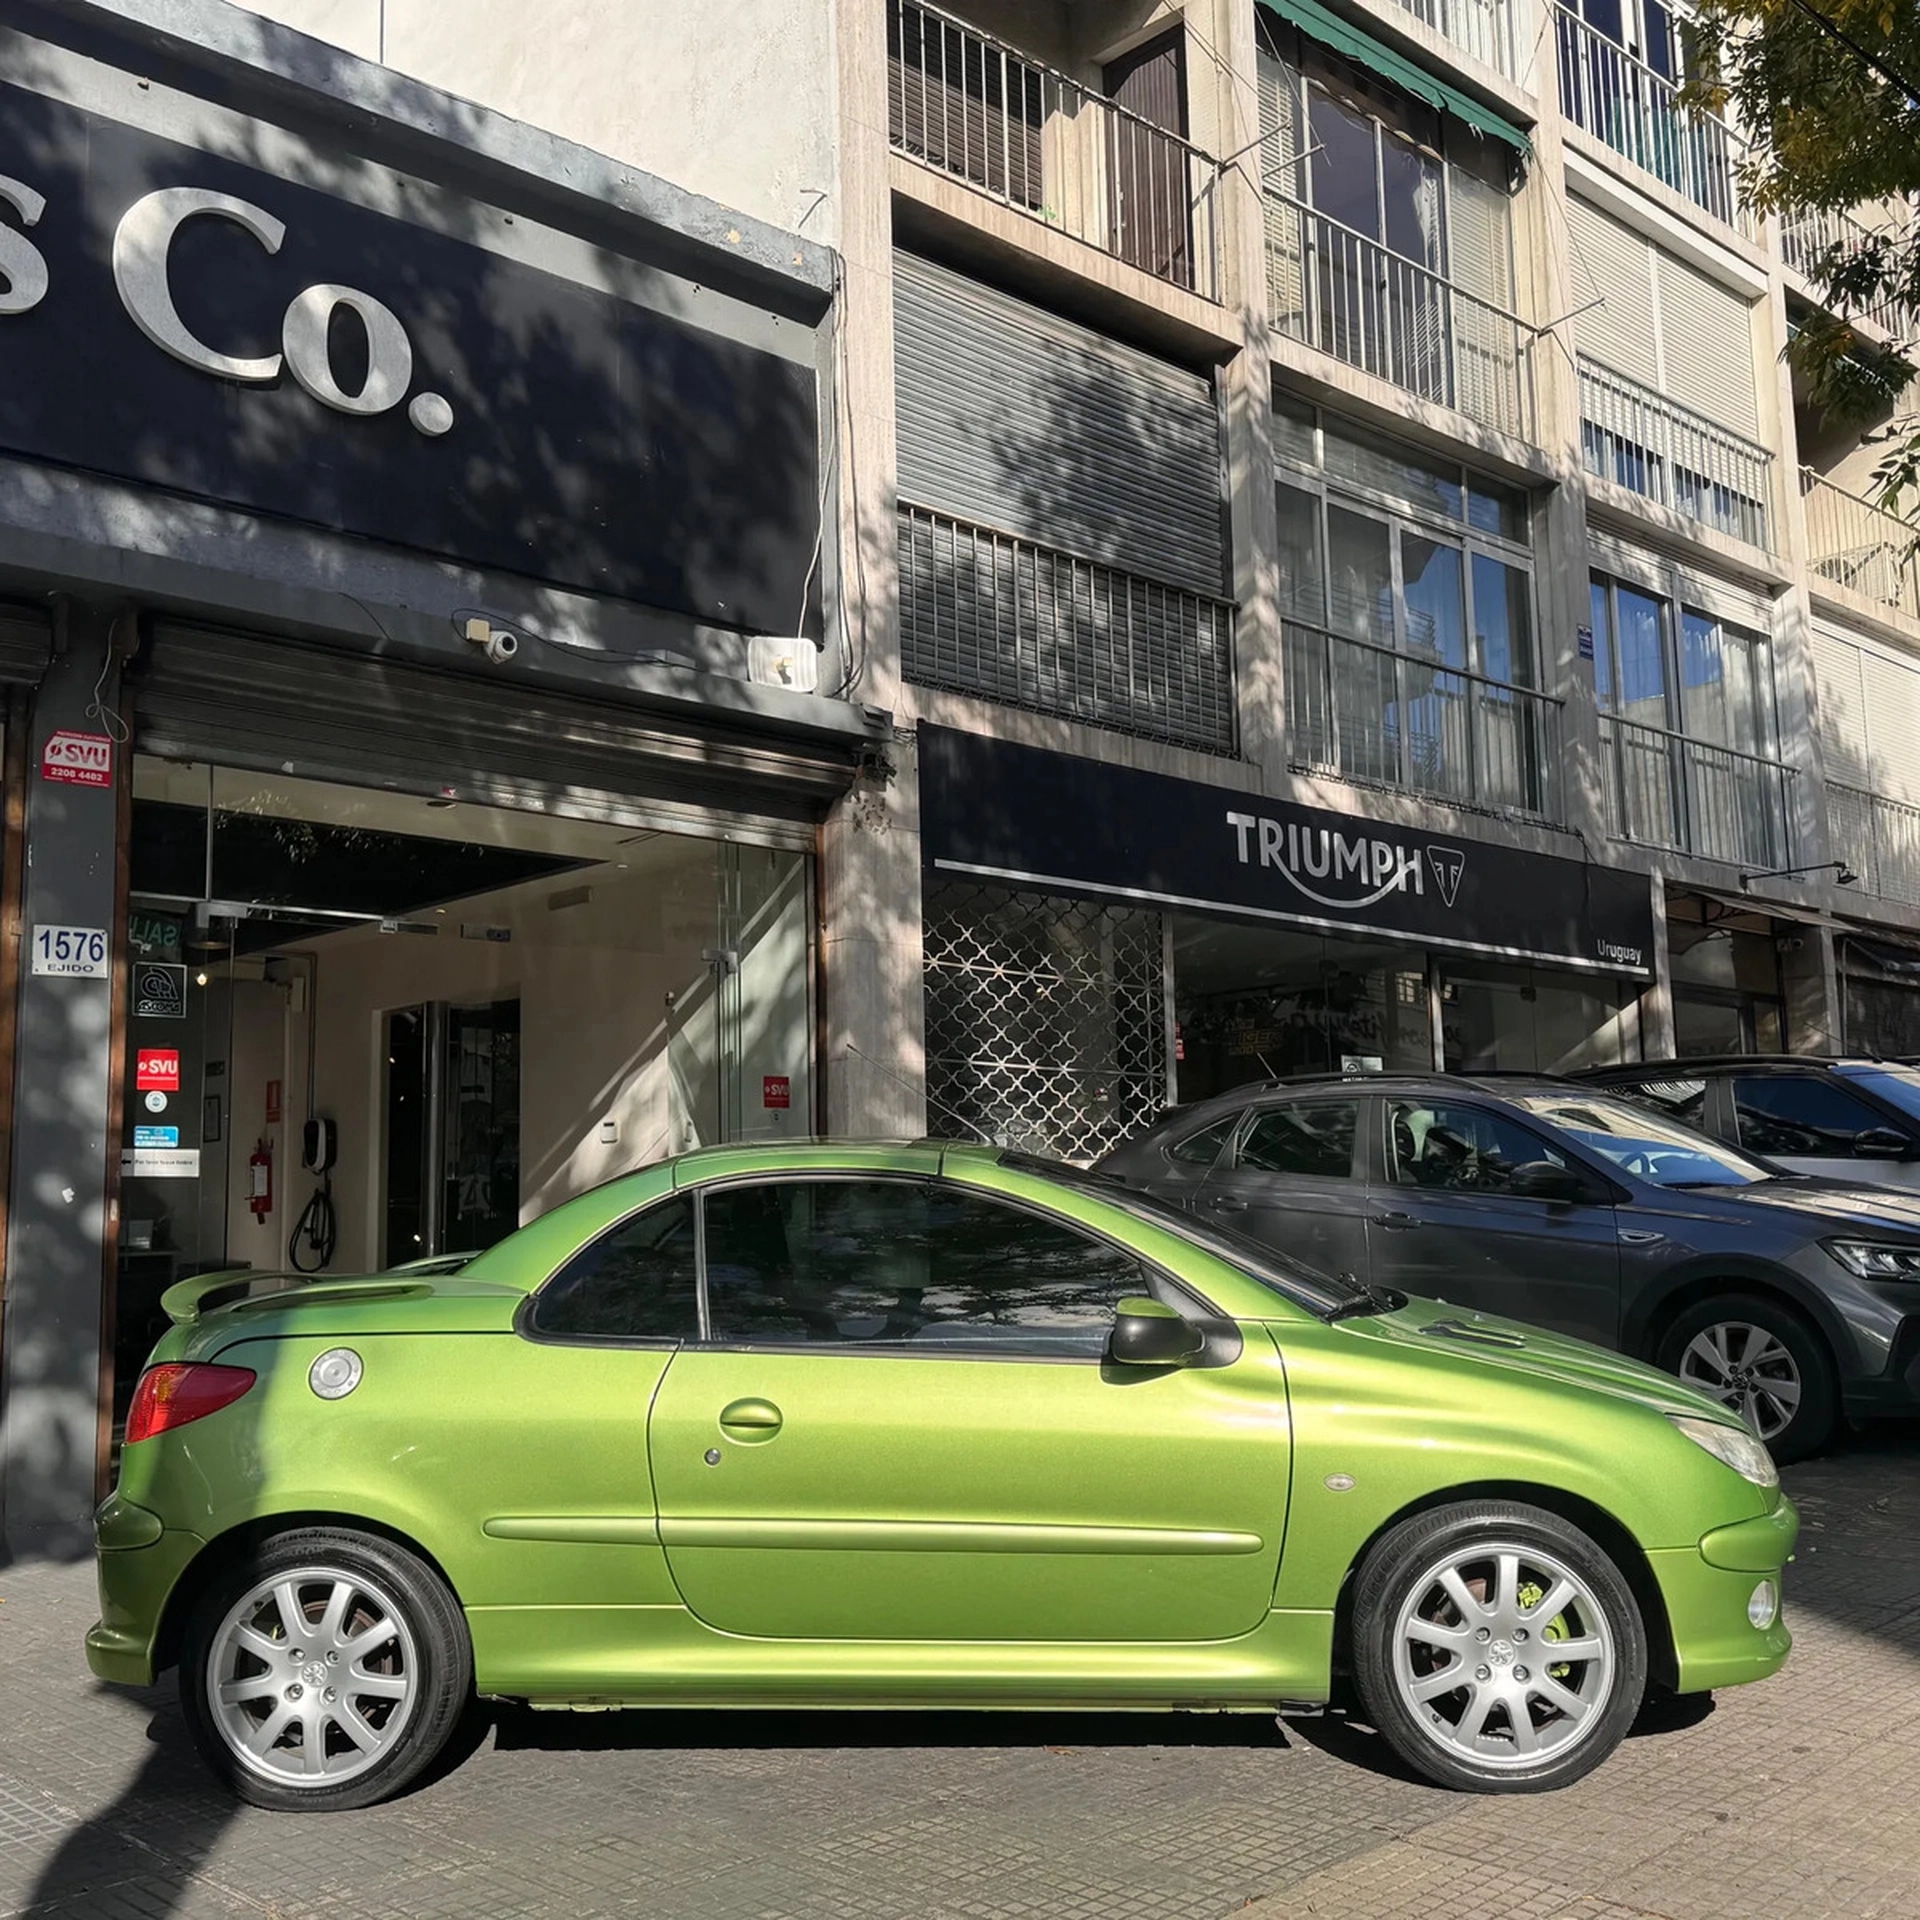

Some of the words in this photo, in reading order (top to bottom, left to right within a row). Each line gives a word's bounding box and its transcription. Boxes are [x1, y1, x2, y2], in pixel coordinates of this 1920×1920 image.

[112, 186, 454, 436] Co.
[65, 743, 107, 768] SVU
[51, 767, 76, 778] 2208
[1226, 811, 1424, 908] TRIUMPH
[39, 929, 104, 962] 1576
[1597, 939, 1642, 965] Uruguay
[47, 964, 94, 973] EJIDO
[149, 1059, 177, 1075] SVU
